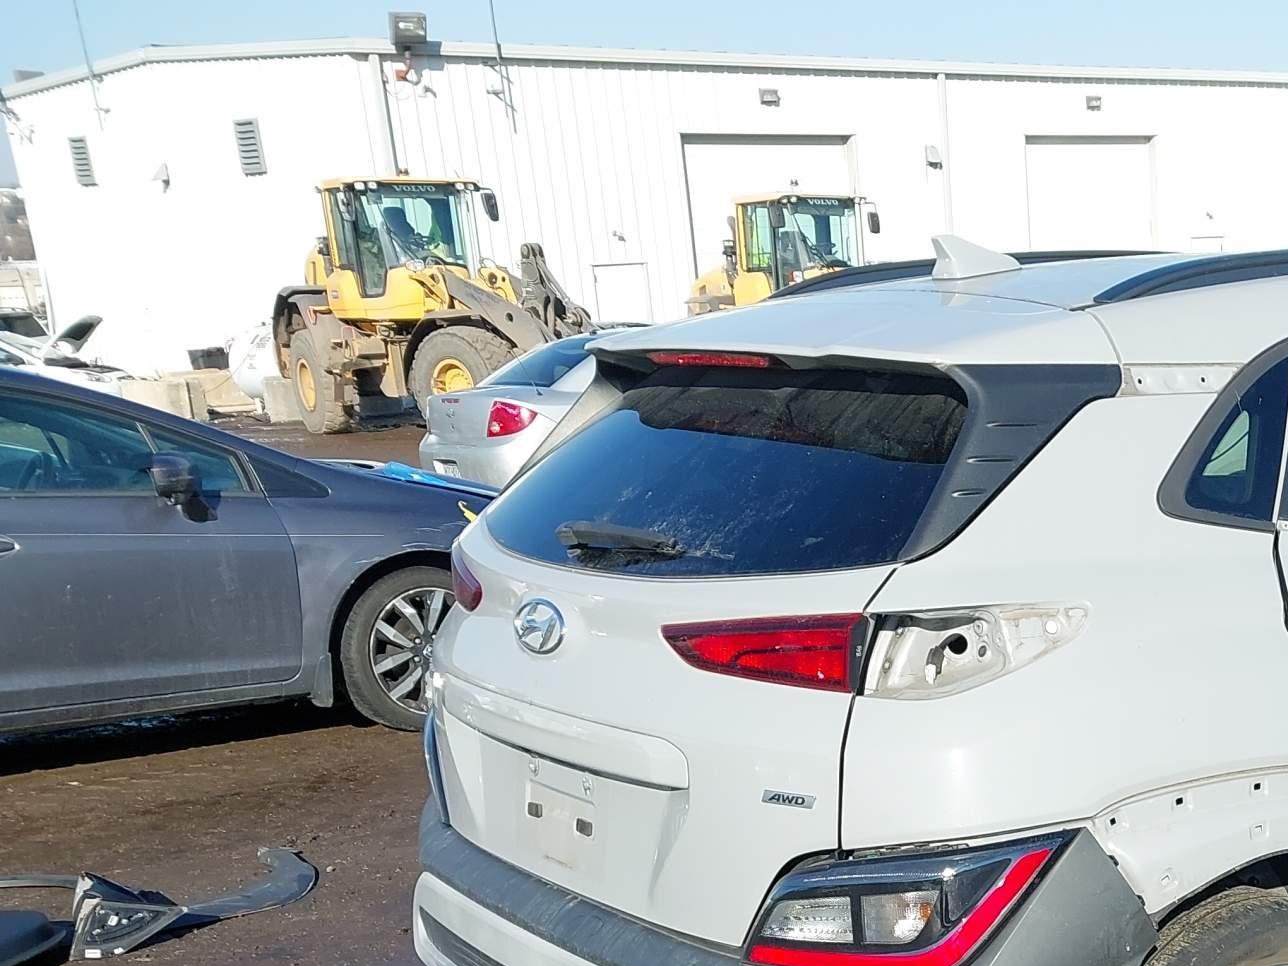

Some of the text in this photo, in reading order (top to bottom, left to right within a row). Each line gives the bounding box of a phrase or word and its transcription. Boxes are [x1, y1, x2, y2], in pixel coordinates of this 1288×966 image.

[392, 184, 436, 192] VOLVO
[806, 198, 839, 206] VOLVO
[767, 793, 806, 806] AWD
